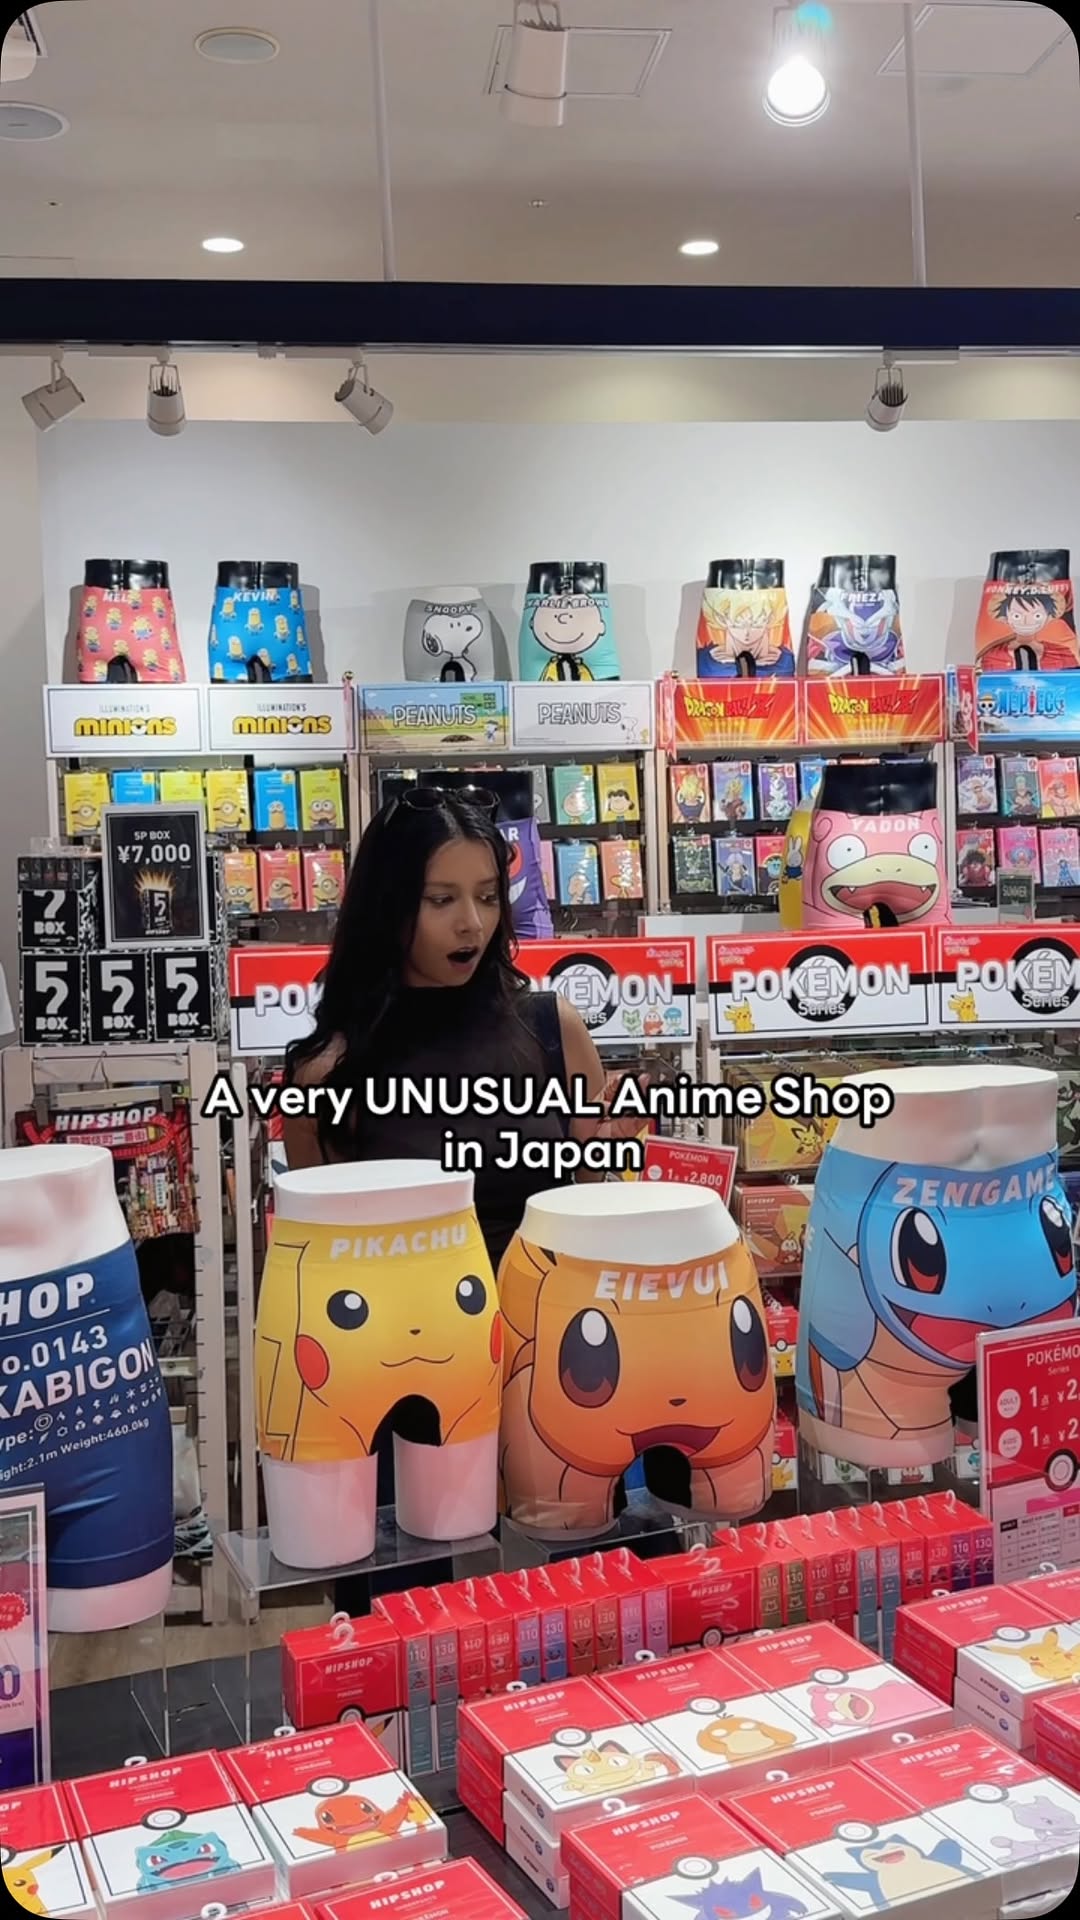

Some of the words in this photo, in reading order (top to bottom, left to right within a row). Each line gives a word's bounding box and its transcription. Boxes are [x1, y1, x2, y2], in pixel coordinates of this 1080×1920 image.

[232, 591, 275, 602] KEVIN
[424, 604, 473, 614] SNOOPY
[537, 702, 622, 725] PEANUTS
[683, 694, 724, 718] DRAGON
[828, 693, 869, 716] DRAGON
[393, 703, 478, 727] PEANUTS
[149, 830, 171, 840] BOX
[851, 818, 921, 833] YADON
[117, 844, 191, 865] ¥7,000
[34, 921, 66, 935] BOX
[731, 957, 911, 1001] POKÉMON
[797, 1000, 847, 1017] Series
[1021, 990, 1070, 1010] Series
[36, 1016, 69, 1030] BOX
[102, 1015, 135, 1029] BOX
[167, 1012, 200, 1027] BOX
[55, 1106, 157, 1131] HIPSHOP
[668, 1149, 710, 1164] POKÉMON
[892, 1163, 1057, 1208] ZENIGAME
[329, 1223, 468, 1261] PIKACHU
[594, 1261, 729, 1300] EIEVUI
[1047, 1365, 1070, 1376] Series
[60, 1416, 150, 1455] Weight:460.0kg
[952, 1540, 970, 1553] 110
[974, 1536, 993, 1549] 130
[761, 1574, 779, 1588] 110
[785, 1570, 804, 1584] 130
[811, 1566, 828, 1580] 110
[573, 1617, 592, 1630] 110
[520, 1628, 539, 1641] 110
[757, 1634, 813, 1653] HIPSHOP
[409, 1649, 427, 1662] 110
[434, 1643, 455, 1656] 130
[325, 1656, 374, 1675] HIPSHOP
[636, 1661, 695, 1681] HIPSHOP
[502, 1690, 566, 1712] HIPSHOP
[265, 1737, 335, 1759] HIPSHOP
[899, 1743, 962, 1766] HIPSHOP
[109, 1766, 183, 1789] HIPSHOP
[770, 1780, 836, 1804] HIPSHOP
[611, 1810, 681, 1836] HIPSHOP
[369, 1879, 446, 1909] HIPSHOP
